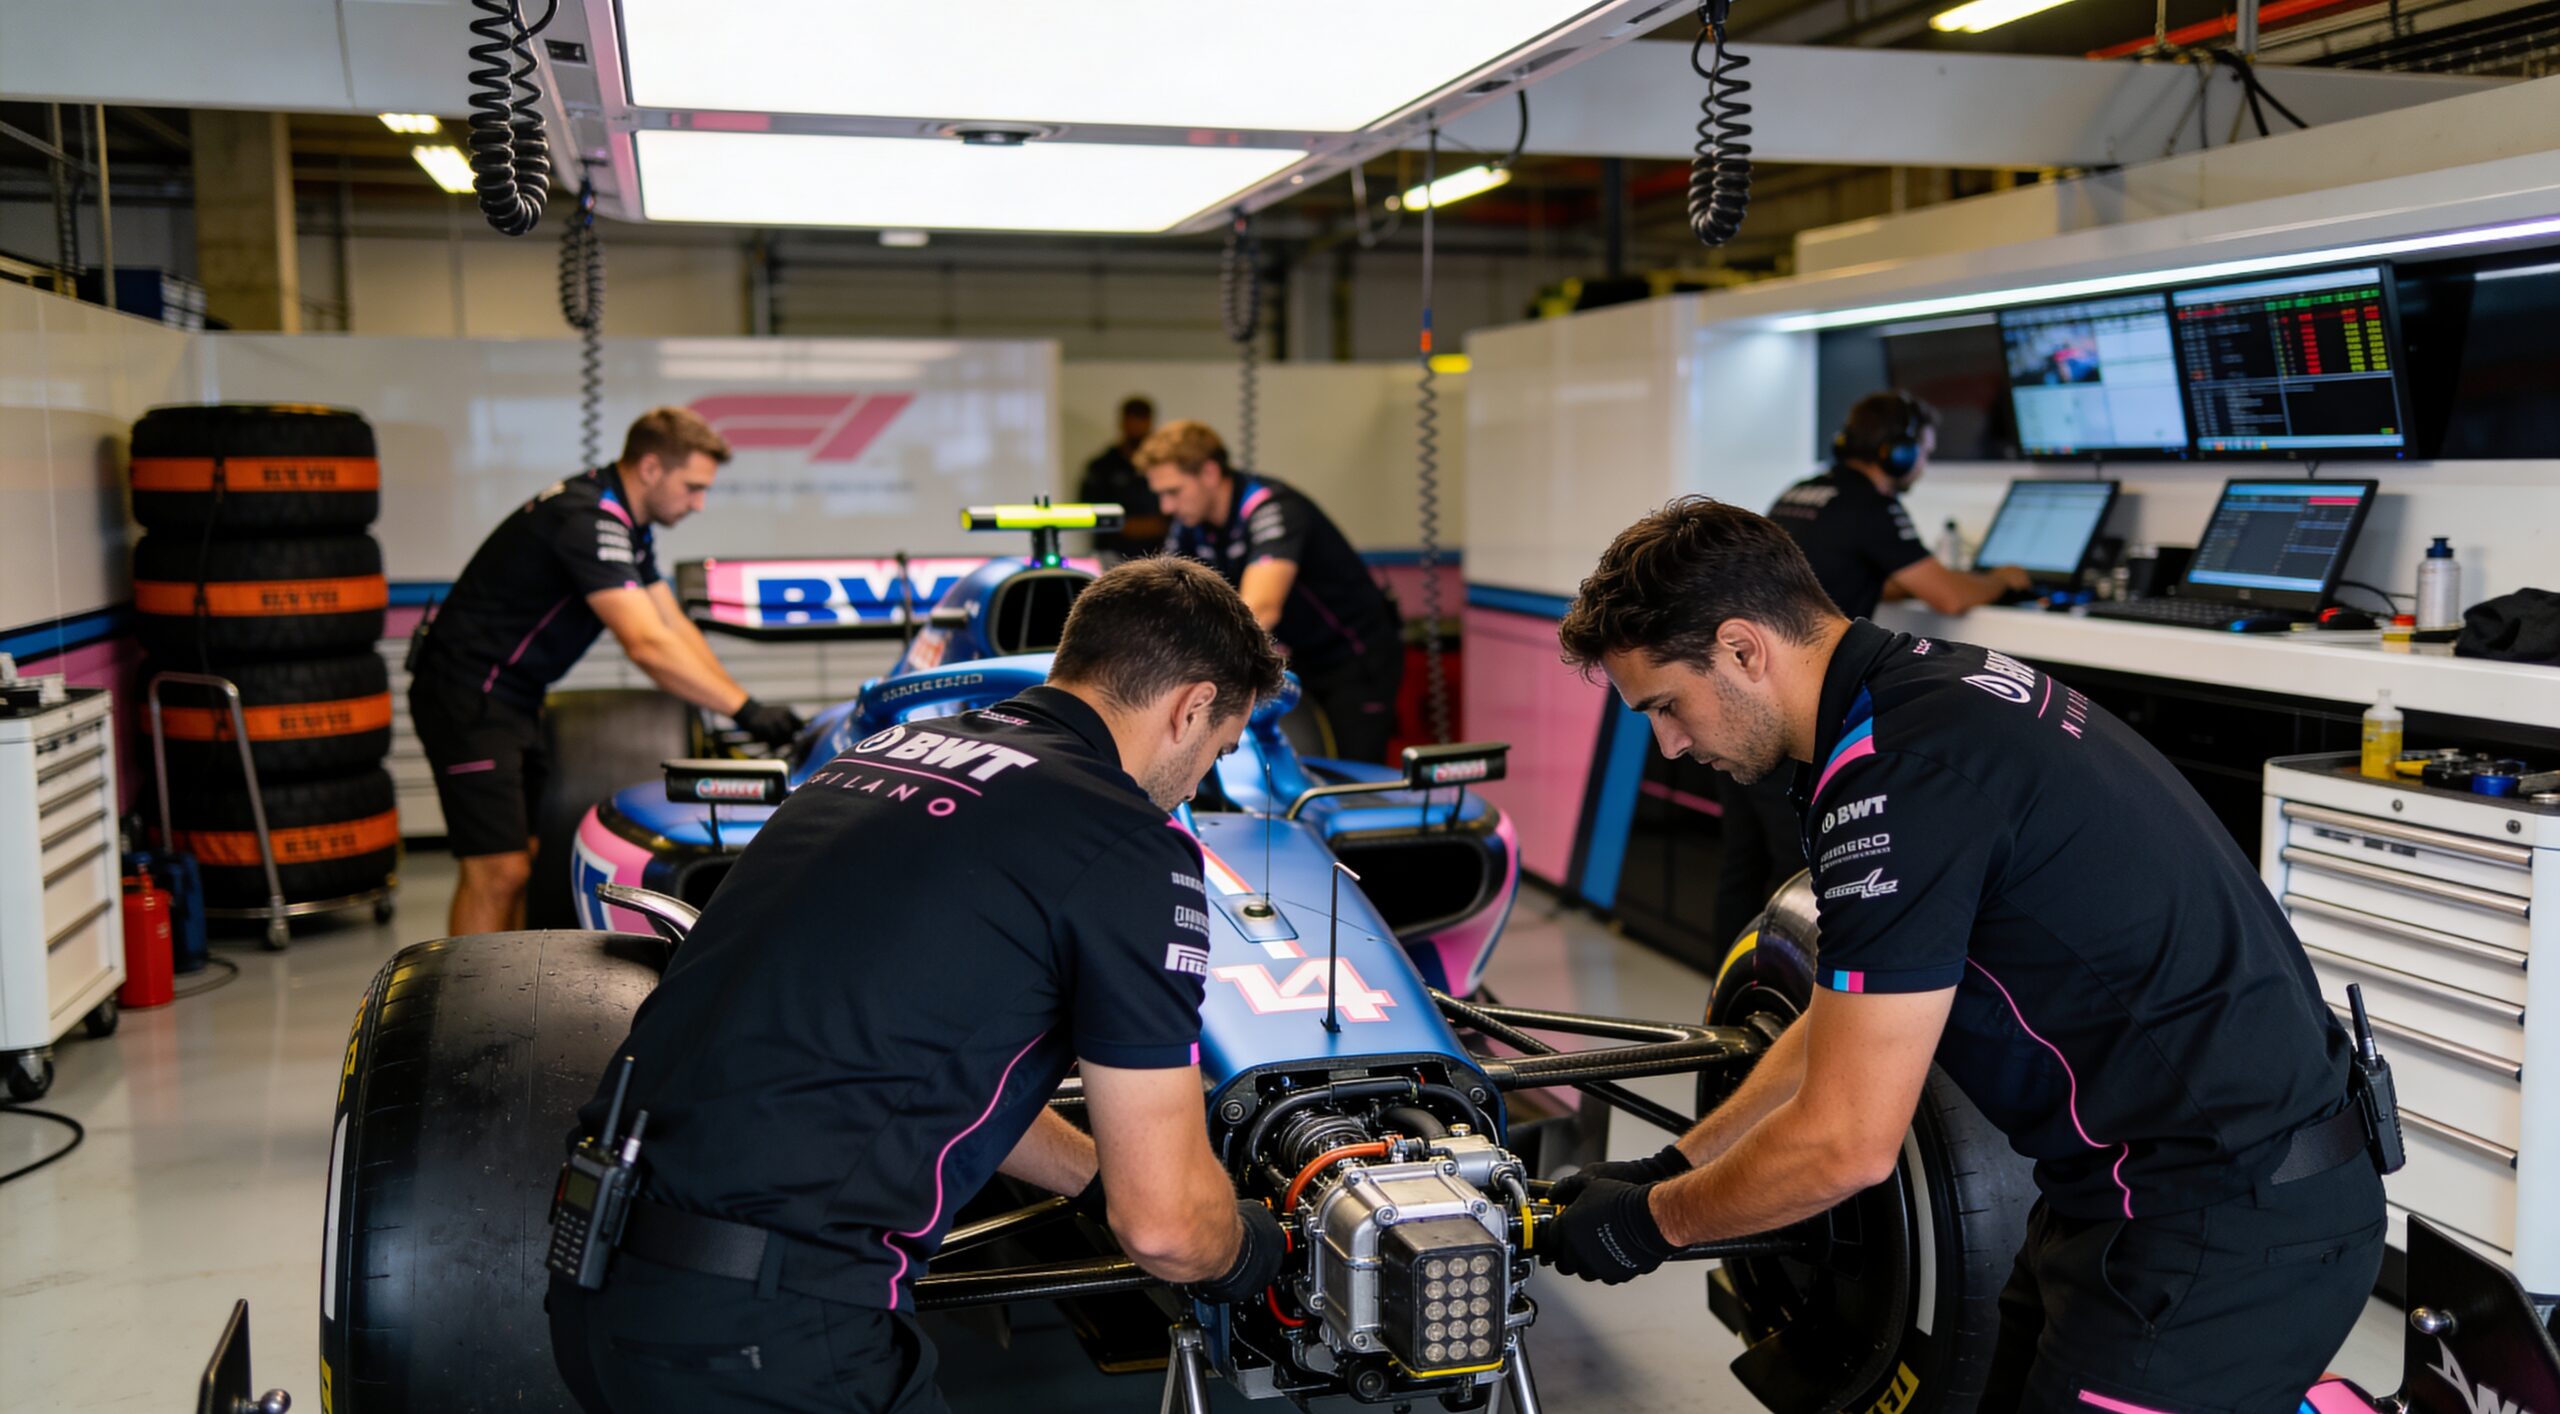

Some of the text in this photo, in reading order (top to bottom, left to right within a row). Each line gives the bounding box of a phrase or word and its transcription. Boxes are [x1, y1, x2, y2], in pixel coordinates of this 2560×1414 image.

[685, 393, 916, 463] F1
[757, 577, 961, 626] BW
[885, 731, 1039, 782] BWT
[1837, 795, 1888, 825] BWT
[1211, 957, 1397, 1022] 14
